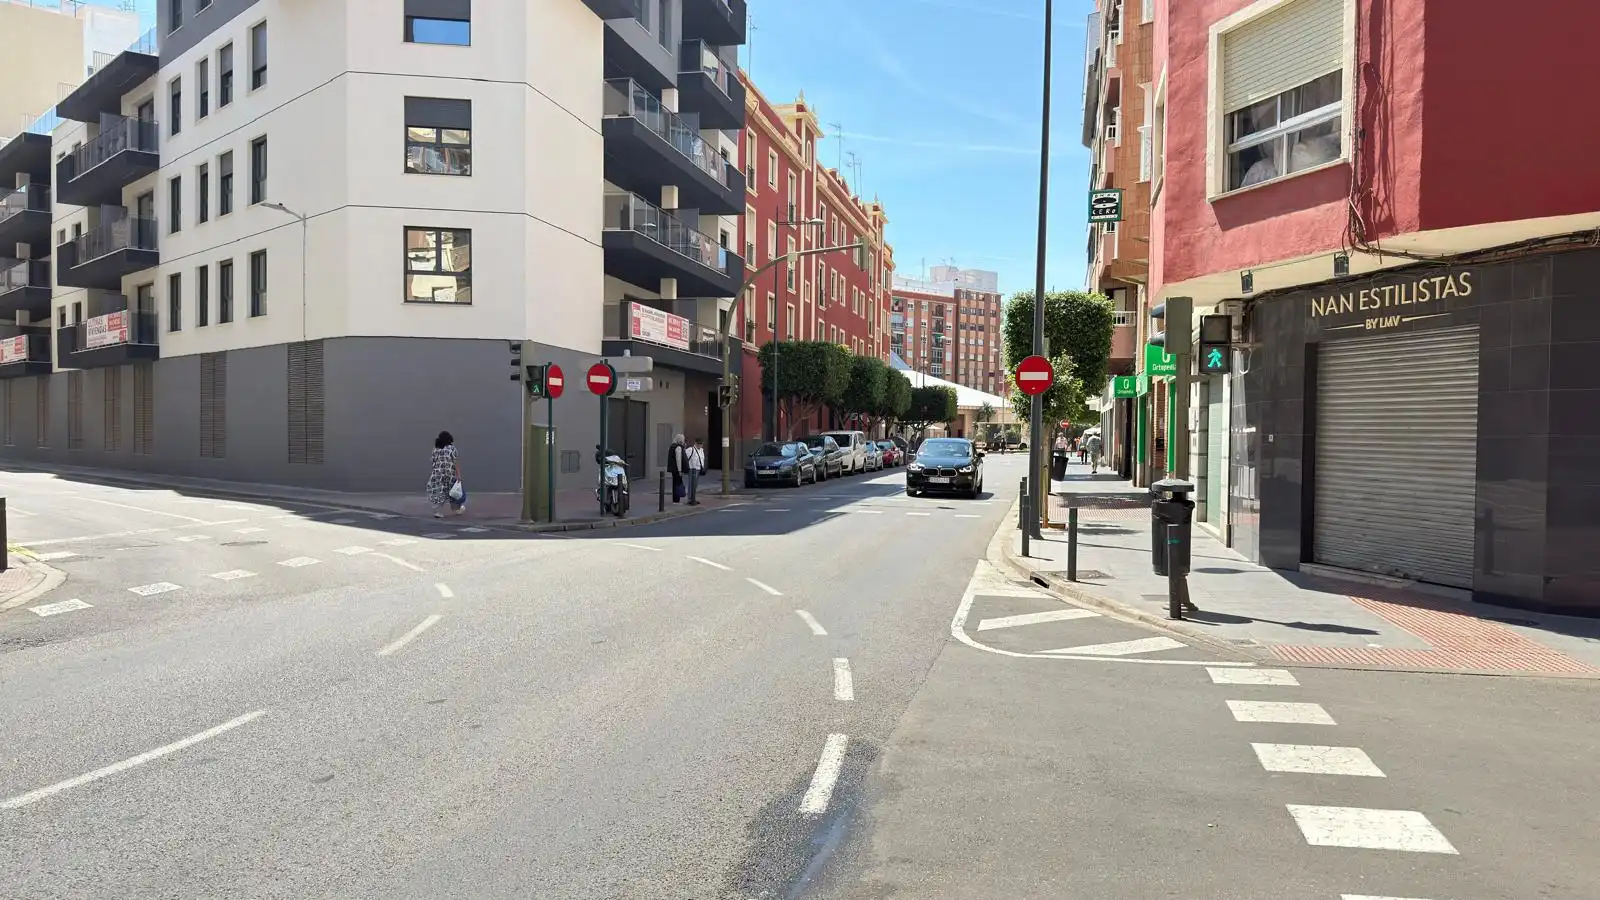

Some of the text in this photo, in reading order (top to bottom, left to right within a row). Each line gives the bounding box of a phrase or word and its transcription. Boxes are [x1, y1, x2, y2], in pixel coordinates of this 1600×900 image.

[1311, 272, 1472, 317] NAN ESTILISTAS
[1365, 315, 1401, 330] BY LMV
